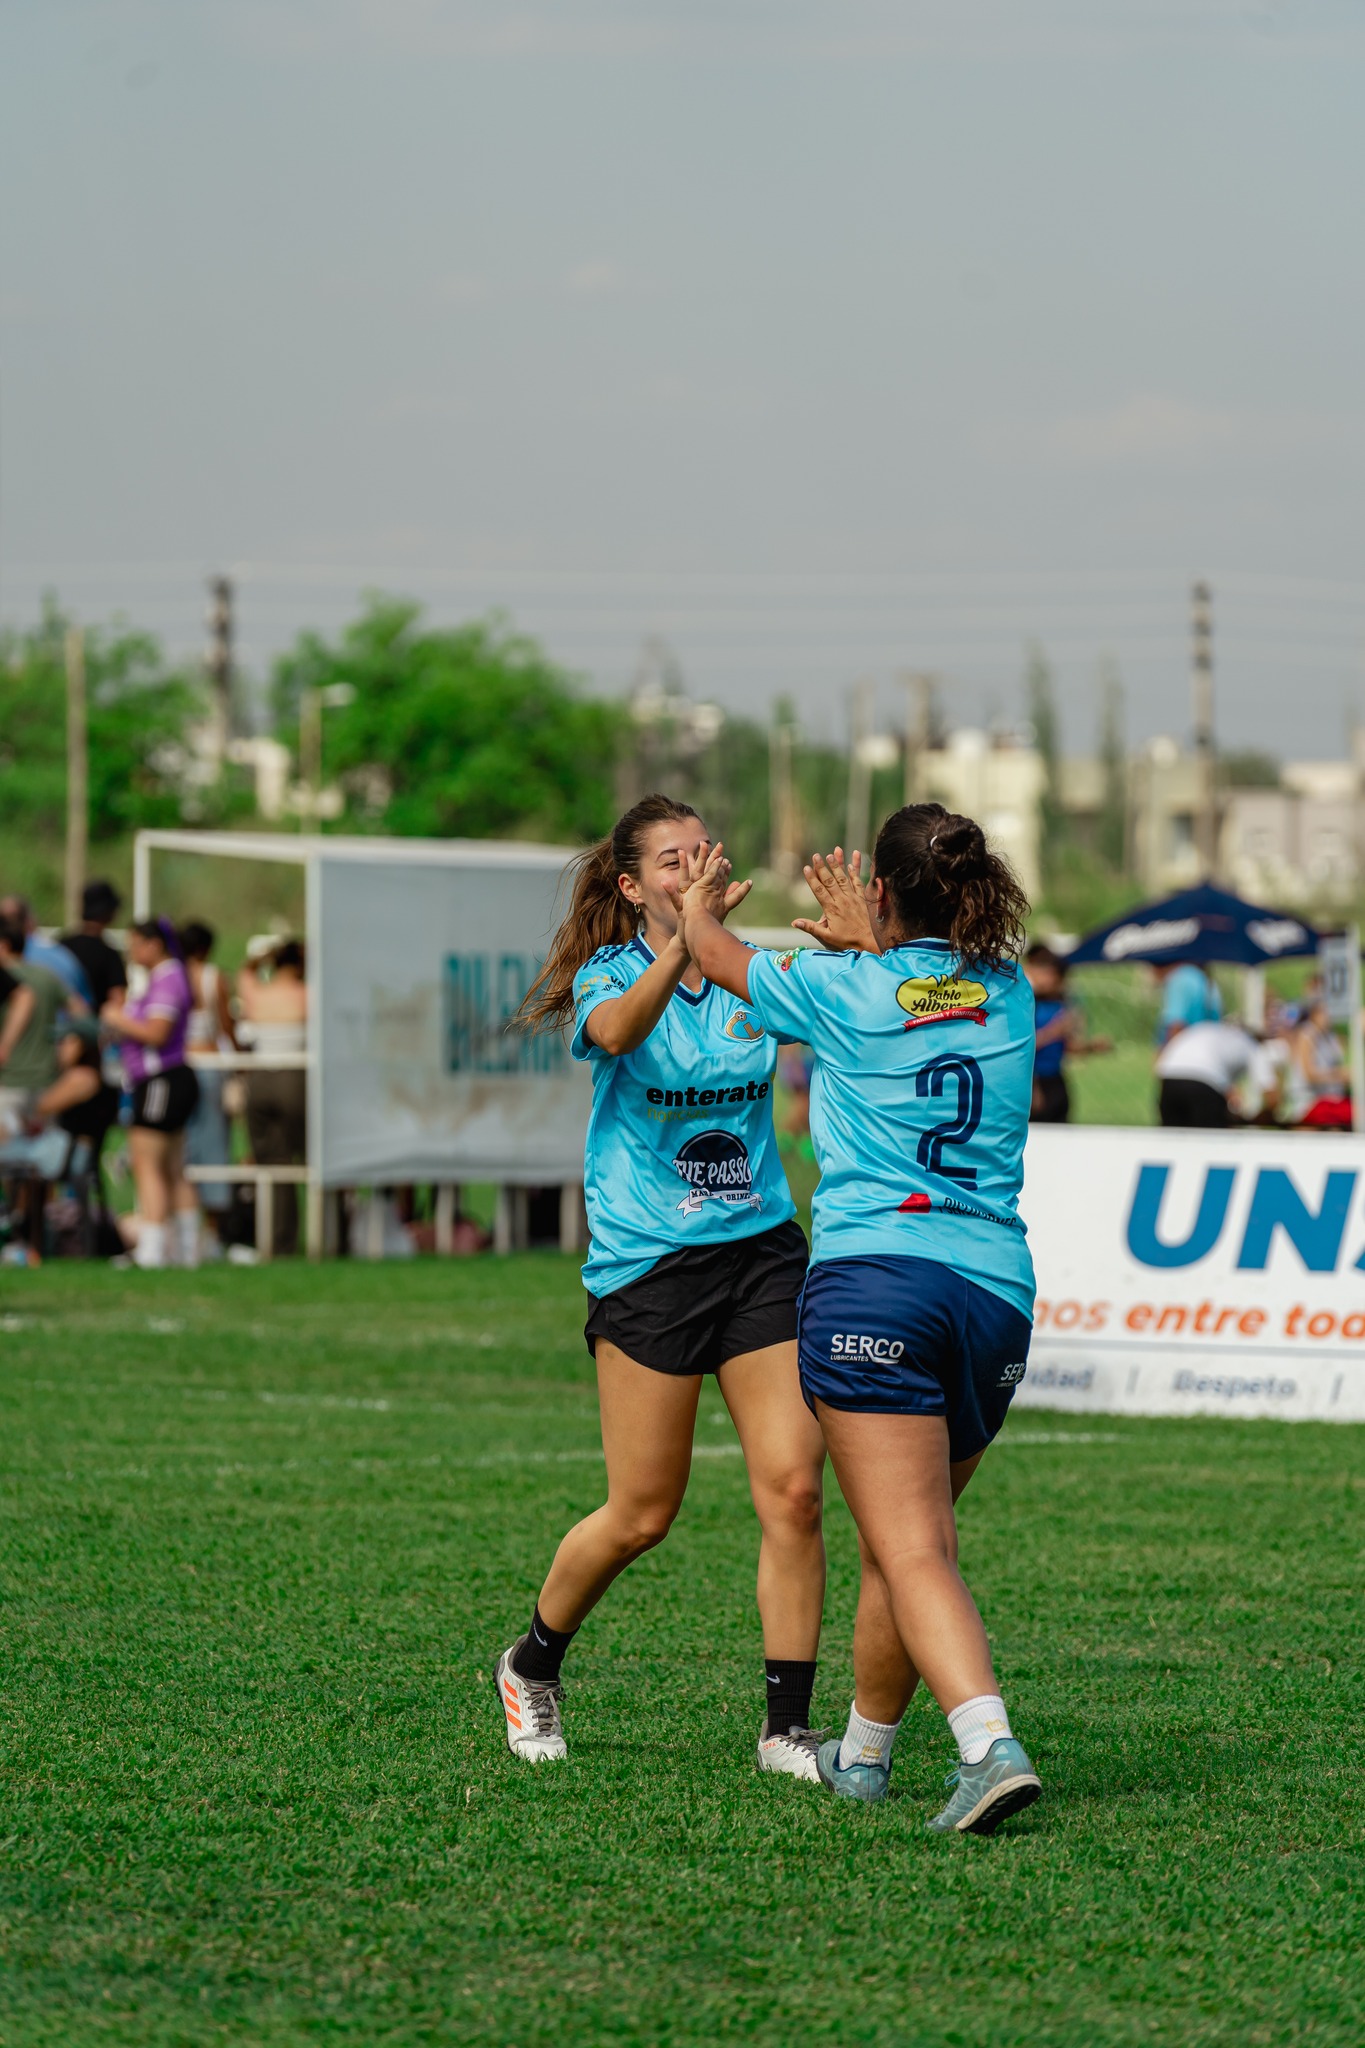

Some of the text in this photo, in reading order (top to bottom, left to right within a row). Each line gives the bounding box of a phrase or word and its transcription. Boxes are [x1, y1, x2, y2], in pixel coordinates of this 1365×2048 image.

[927, 989, 962, 1001] Pablo
[646, 1080, 769, 1107] enterate
[915, 1052, 984, 1191] 2
[1126, 1164, 1365, 1272] UN
[1125, 1300, 1269, 1337] entre
[830, 1333, 905, 1365] SERCO
[830, 1354, 869, 1362] LUBRICANTES
[1173, 1368, 1299, 1400] Respeto
